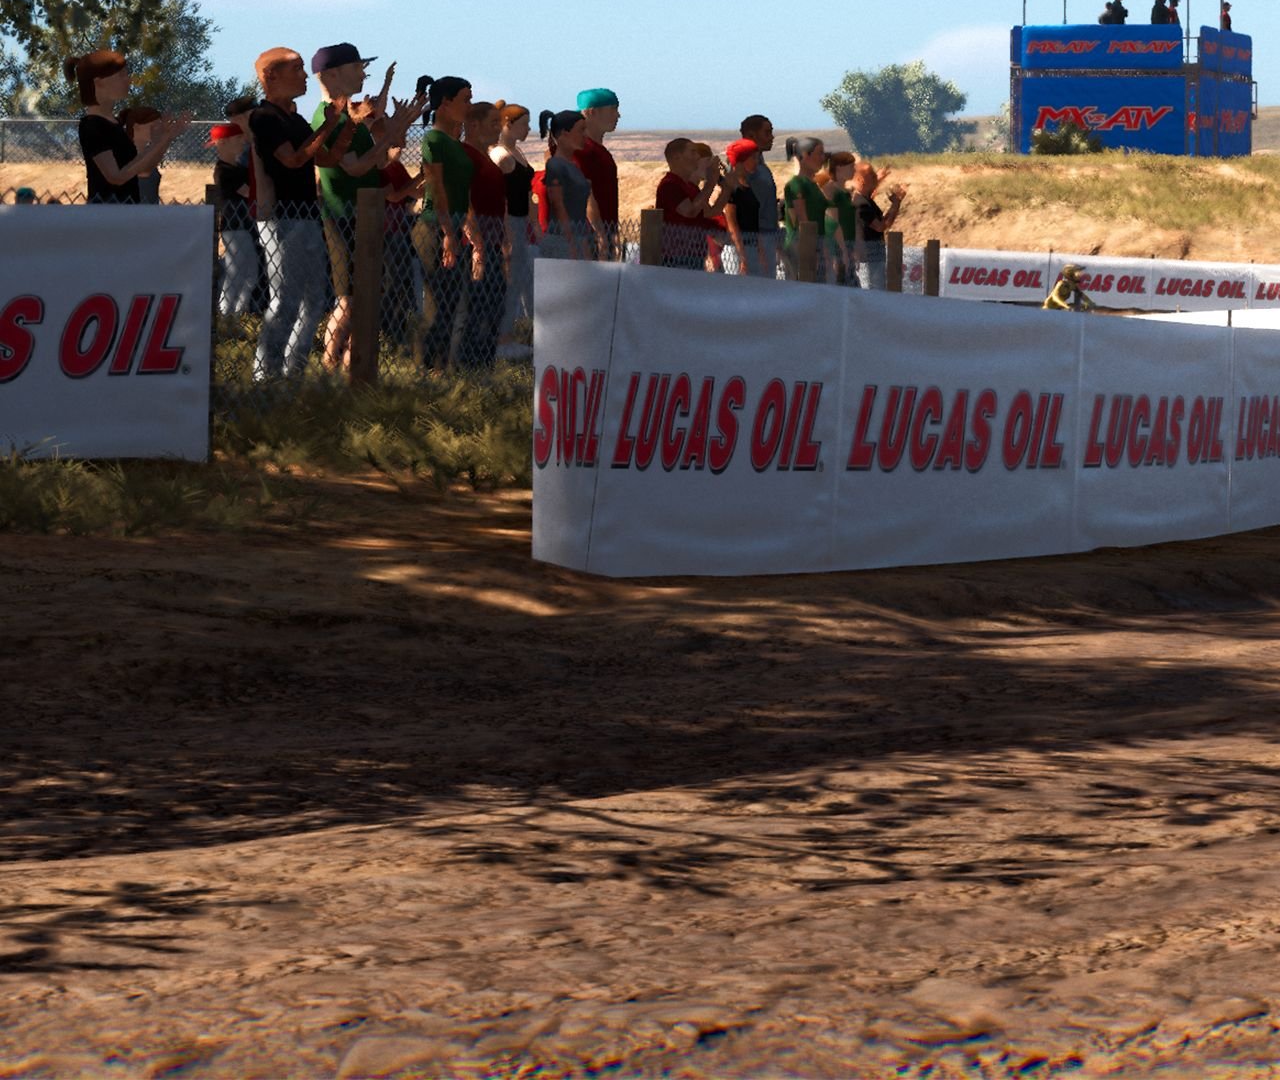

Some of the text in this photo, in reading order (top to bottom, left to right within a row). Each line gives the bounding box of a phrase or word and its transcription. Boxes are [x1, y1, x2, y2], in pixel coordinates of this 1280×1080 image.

[949, 267, 1042, 289] LUCAS OIL
[1116, 275, 1146, 294] OIL
[1156, 278, 1246, 299] LUCAS OIL
[58, 293, 186, 379] OIL
[611, 371, 747, 474] LUCAS
[750, 377, 823, 472] OIL
[847, 384, 1065, 473] LUCAS OIL
[1083, 393, 1225, 469] LUCAS OIL
